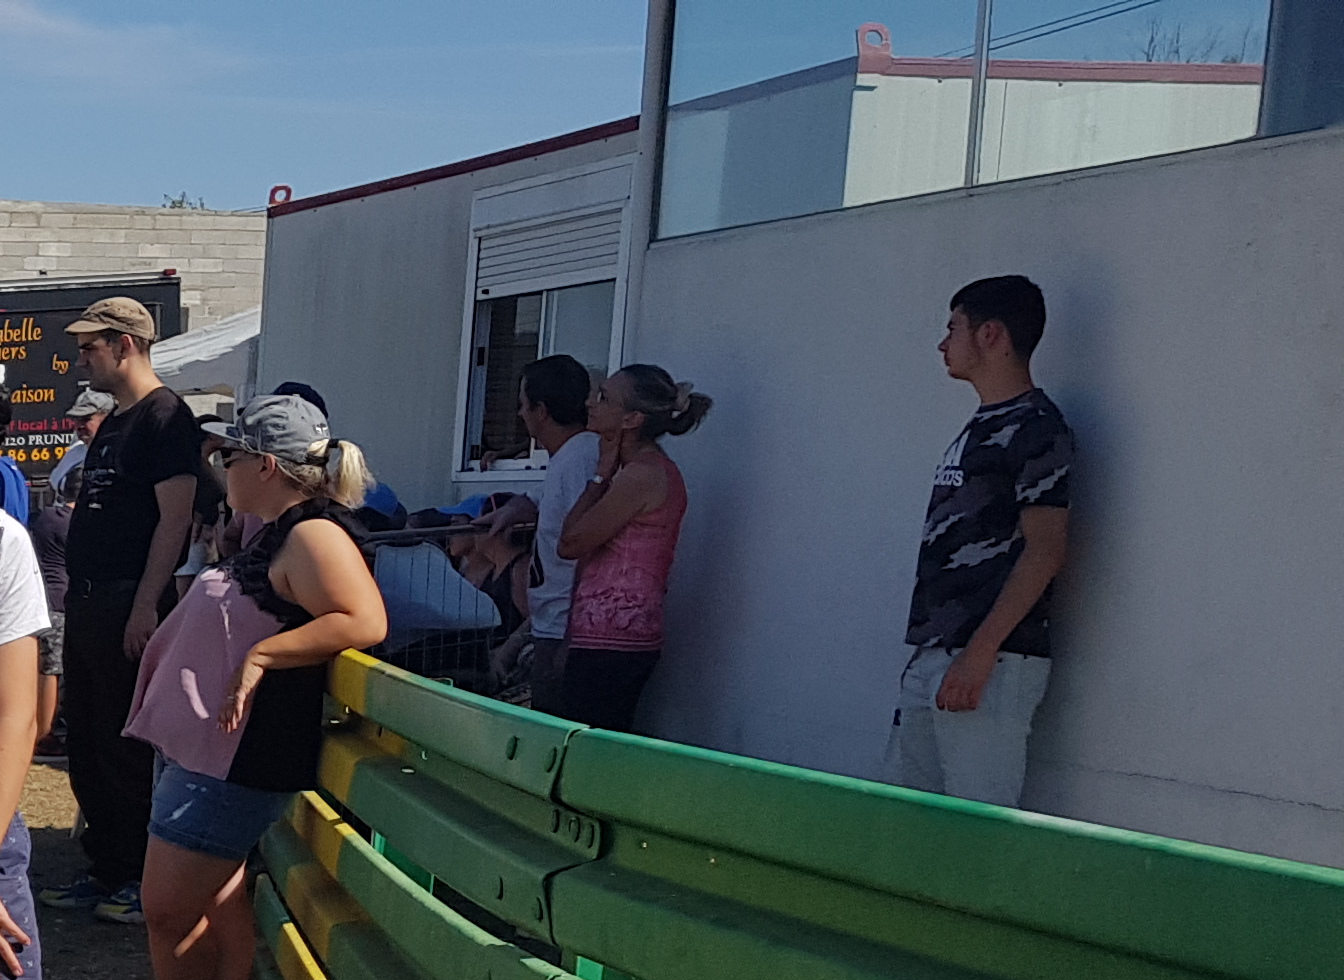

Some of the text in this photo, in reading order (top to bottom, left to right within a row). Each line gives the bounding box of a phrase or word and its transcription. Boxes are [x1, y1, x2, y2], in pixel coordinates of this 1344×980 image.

[52, 353, 70, 375] by
[10, 384, 55, 404] aison
[31, 447, 50, 461] 66
